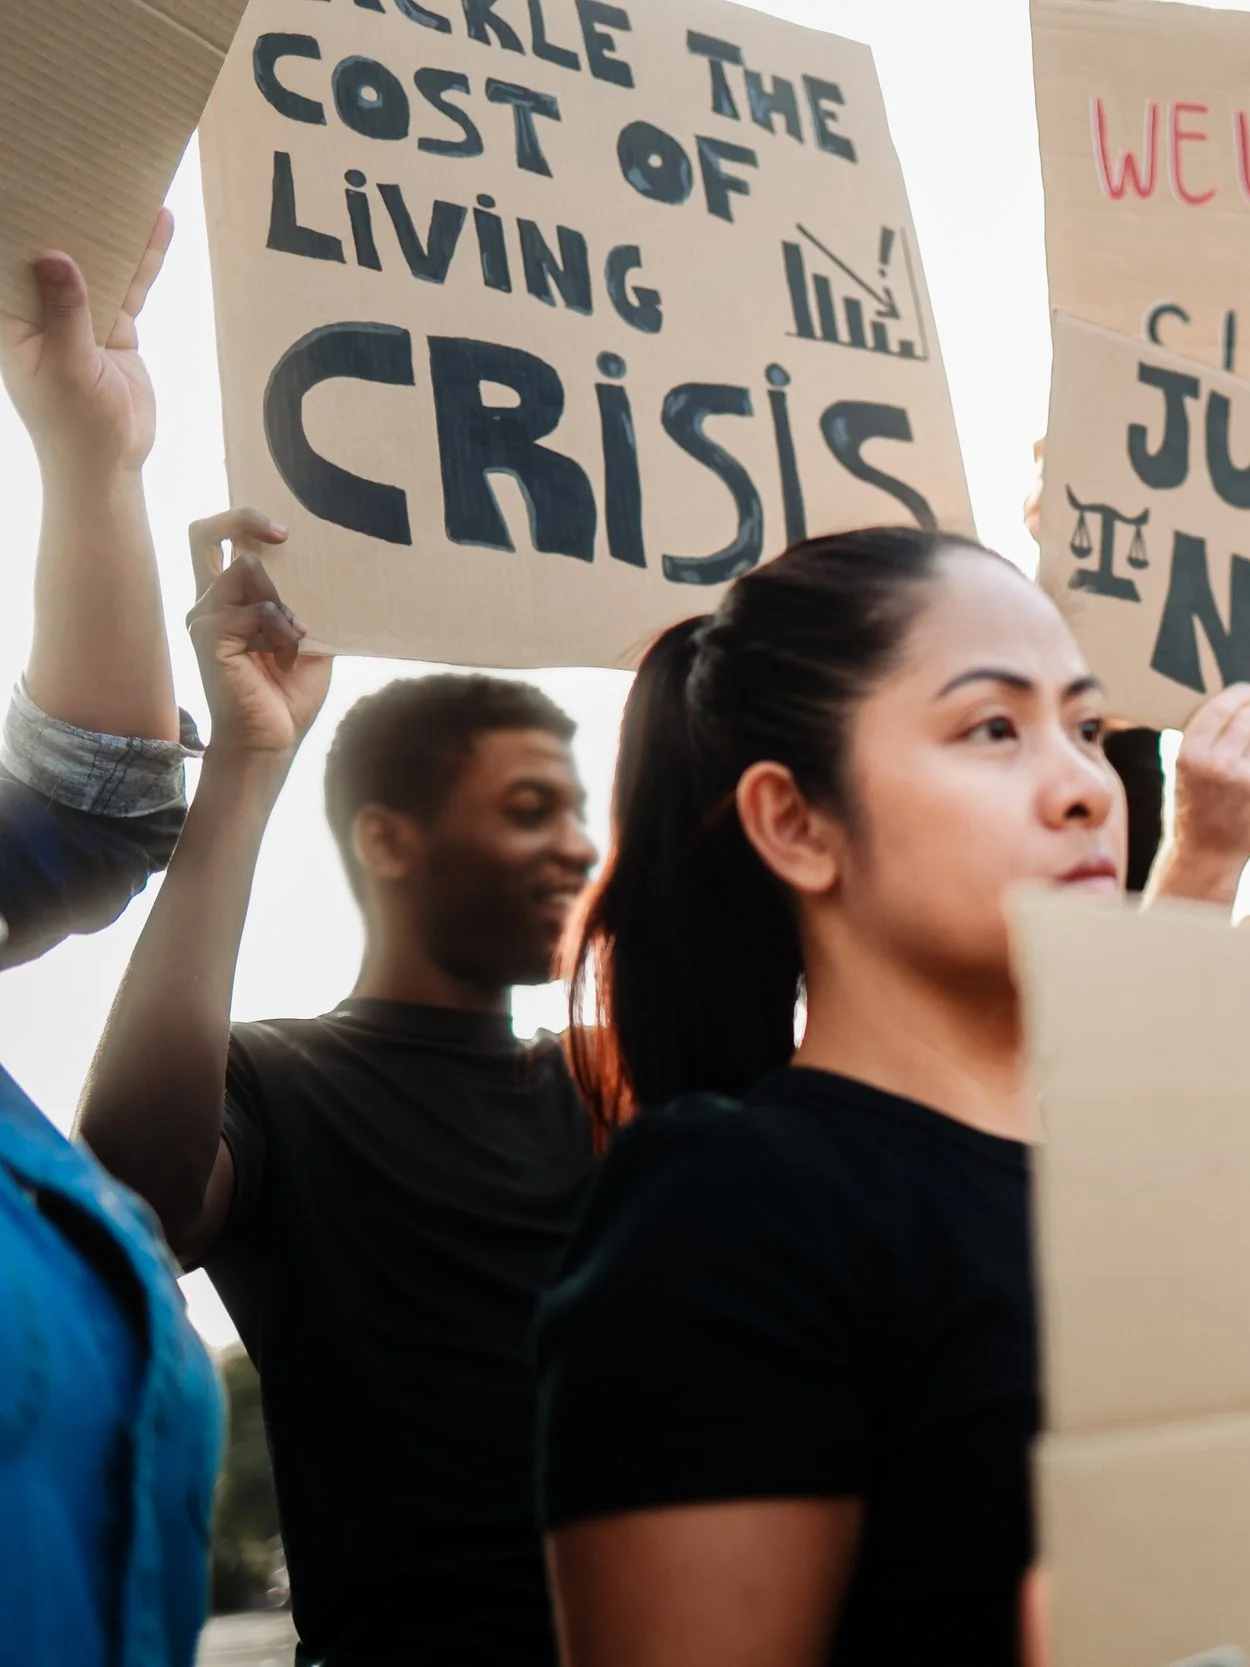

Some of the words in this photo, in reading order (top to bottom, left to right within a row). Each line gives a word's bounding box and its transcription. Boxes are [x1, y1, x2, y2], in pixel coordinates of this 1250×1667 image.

[253, 33, 561, 178] COST
[617, 121, 759, 224] OF
[686, 29, 857, 164] THE
[1091, 96, 1217, 206] WE
